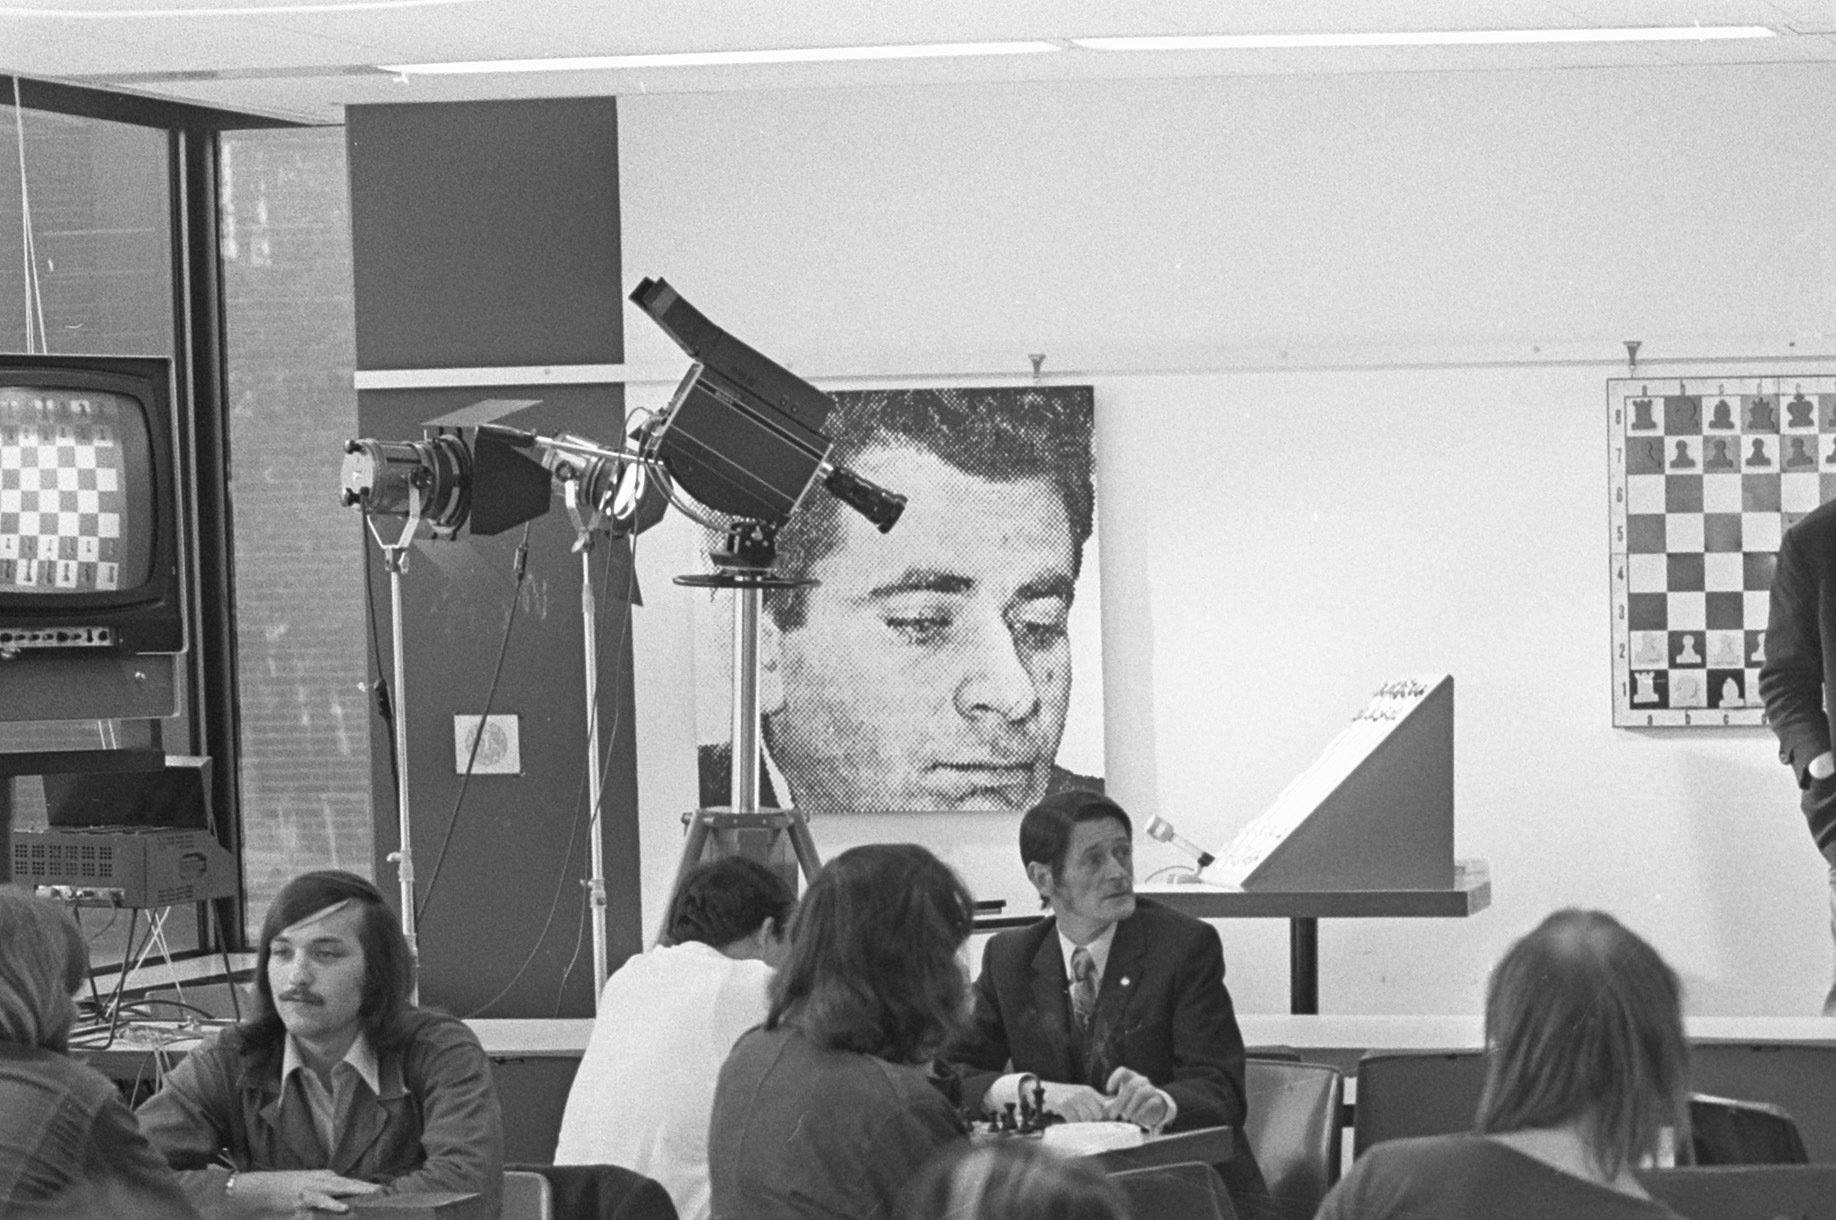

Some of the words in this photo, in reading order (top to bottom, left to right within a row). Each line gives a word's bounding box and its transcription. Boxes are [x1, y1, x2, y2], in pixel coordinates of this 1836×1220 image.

[1615, 409, 1622, 425] 8
[1616, 447, 1622, 464] 7
[1616, 486, 1623, 503] 6
[1617, 525, 1624, 542] 5
[1617, 566, 1624, 580] 4
[1618, 604, 1625, 620] 3
[1619, 643, 1626, 659] 2
